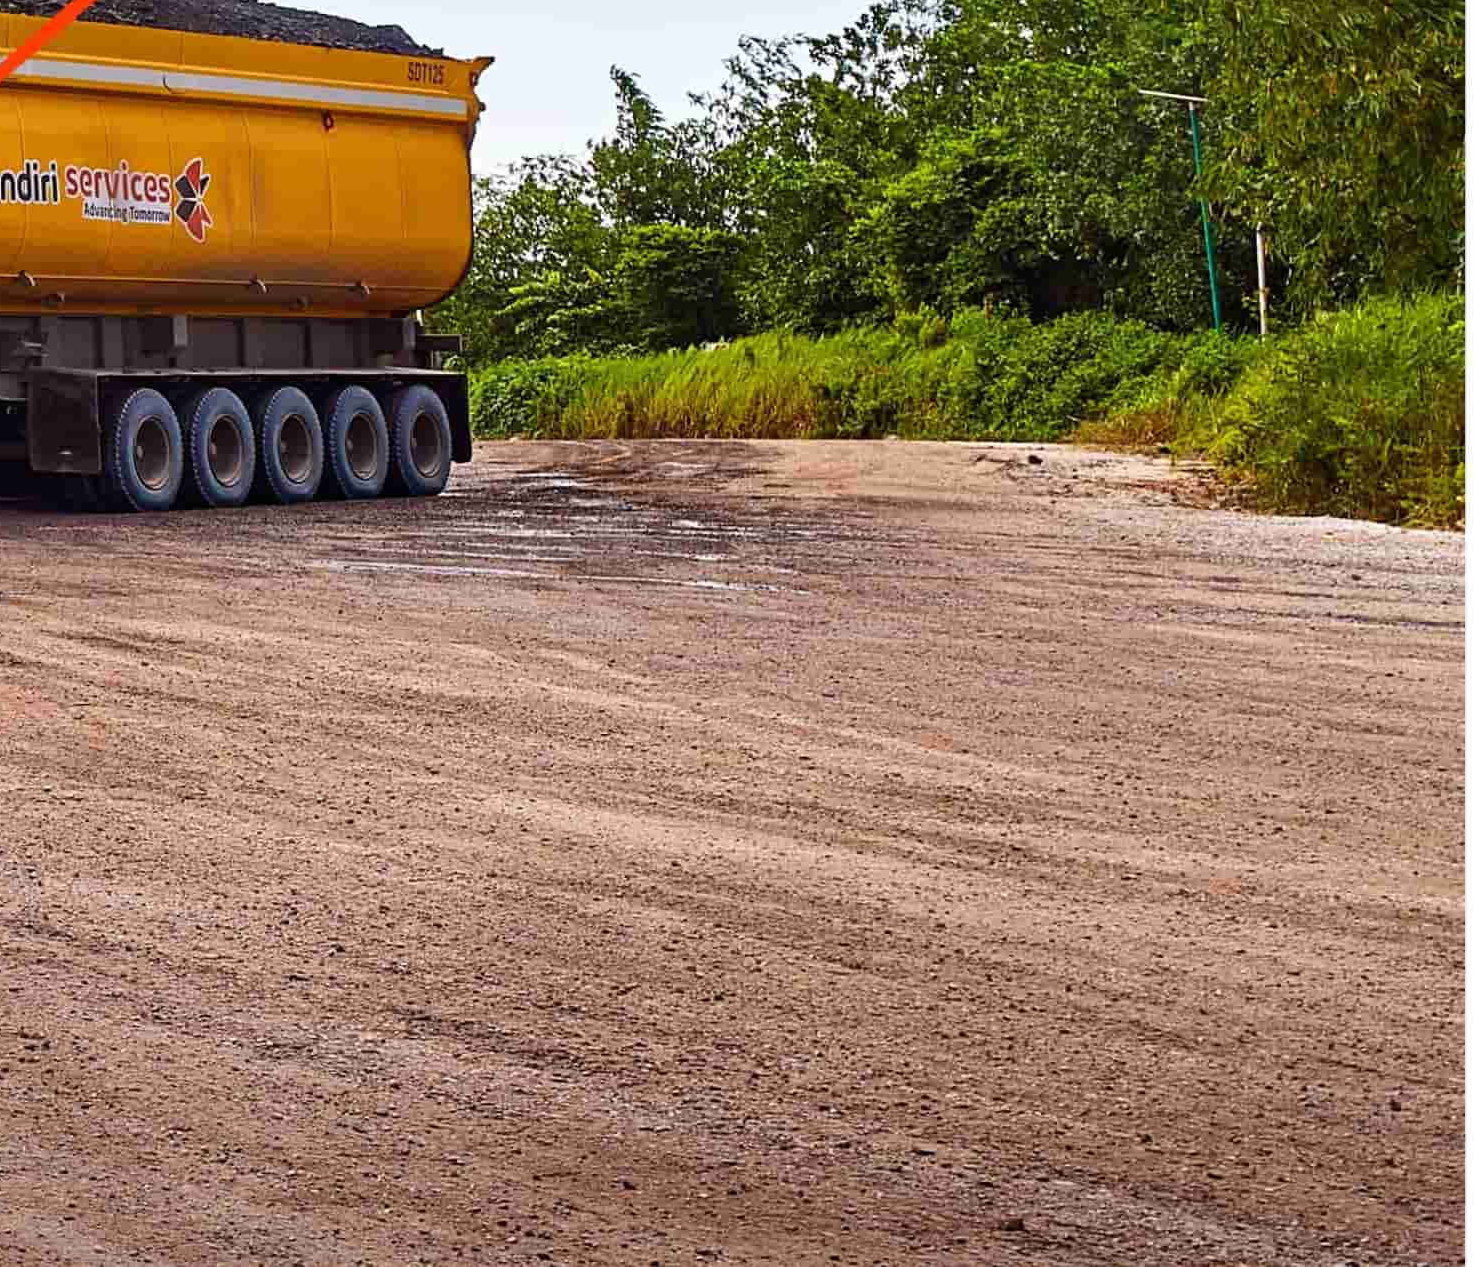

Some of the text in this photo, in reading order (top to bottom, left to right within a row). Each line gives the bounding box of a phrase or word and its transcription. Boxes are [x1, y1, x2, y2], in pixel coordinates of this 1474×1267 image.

[65, 160, 171, 203] services
[84, 202, 170, 223] Advancing Tomorrow
